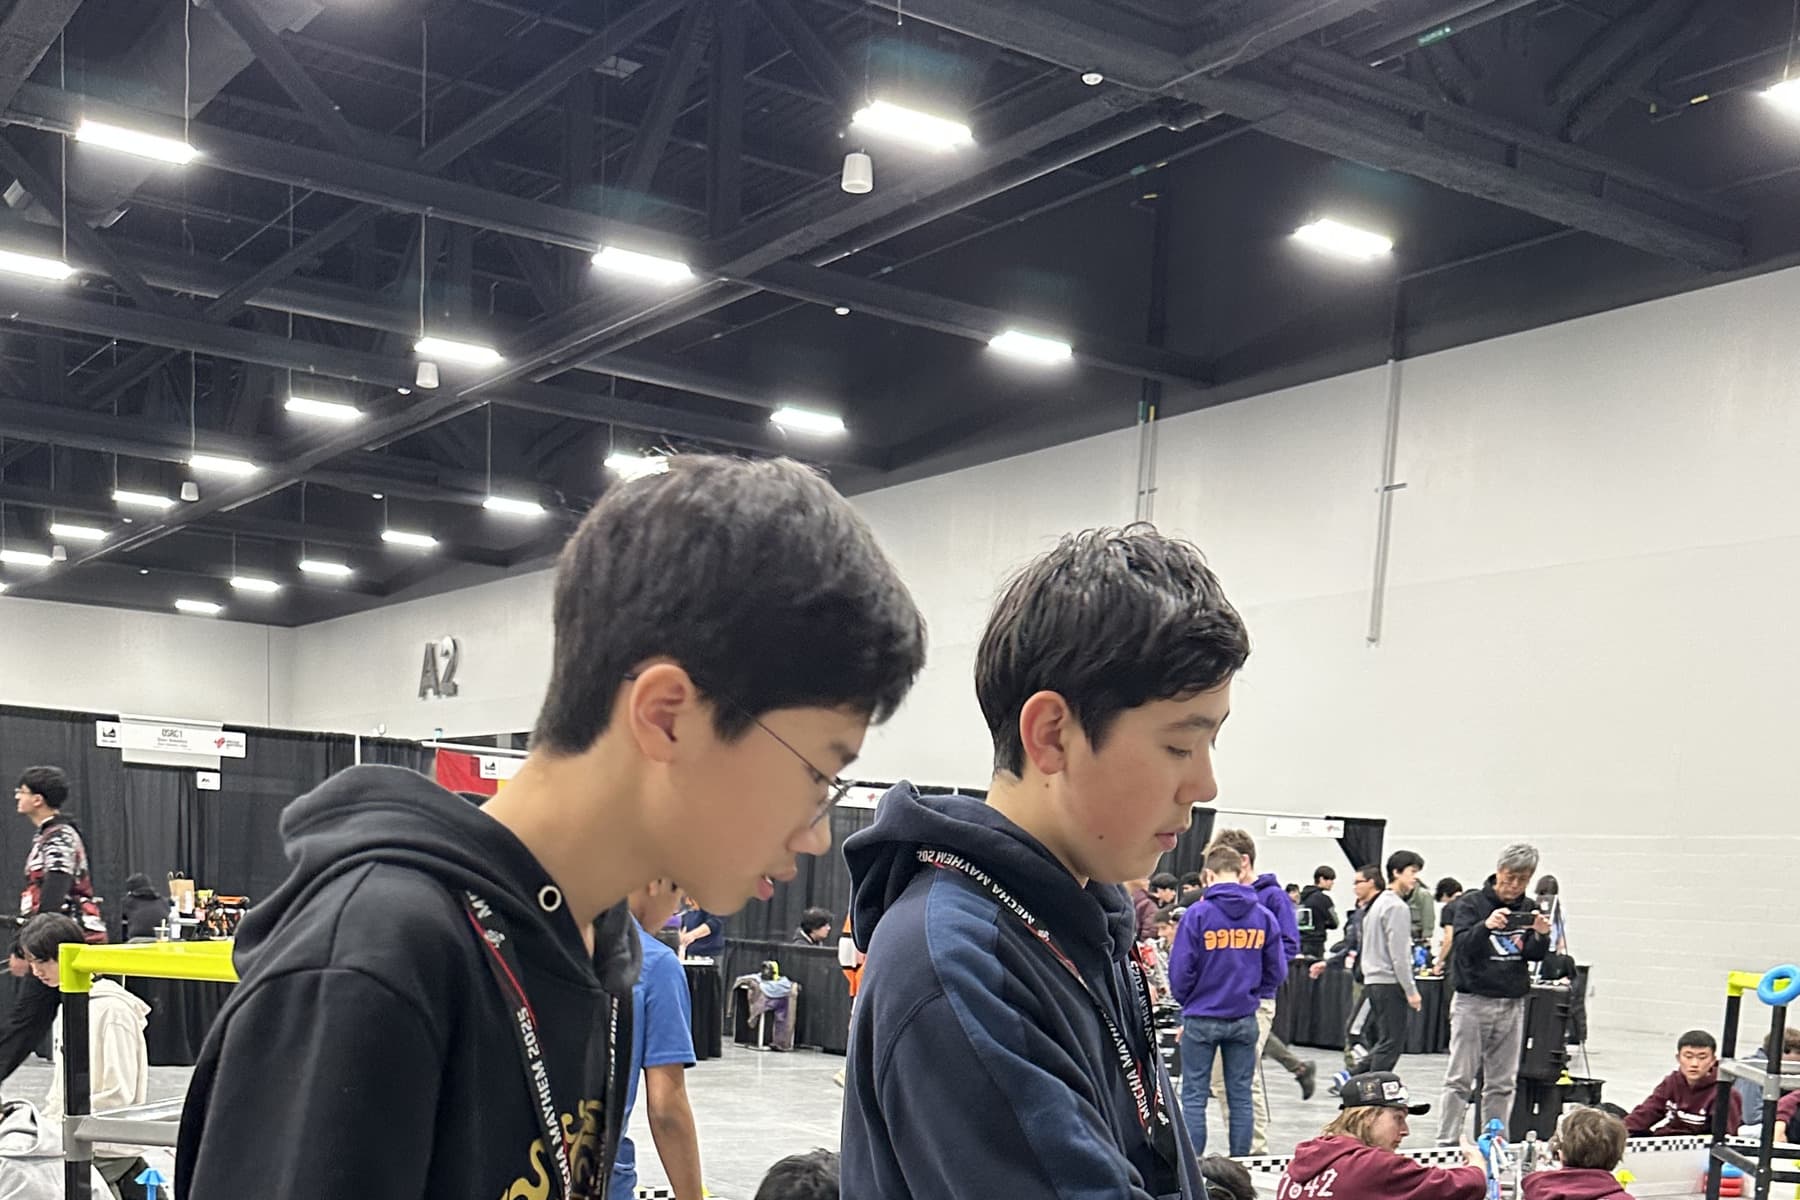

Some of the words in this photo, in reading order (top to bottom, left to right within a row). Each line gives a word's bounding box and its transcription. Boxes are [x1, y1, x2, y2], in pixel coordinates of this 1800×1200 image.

[418, 635, 459, 699] A2
[935, 851, 992, 886] MAYHEM
[992, 883, 1036, 925] MECHA
[516, 1006, 541, 1060] 2025
[530, 1059, 563, 1146] MAYHEM
[1126, 1069, 1151, 1120] MECHA
